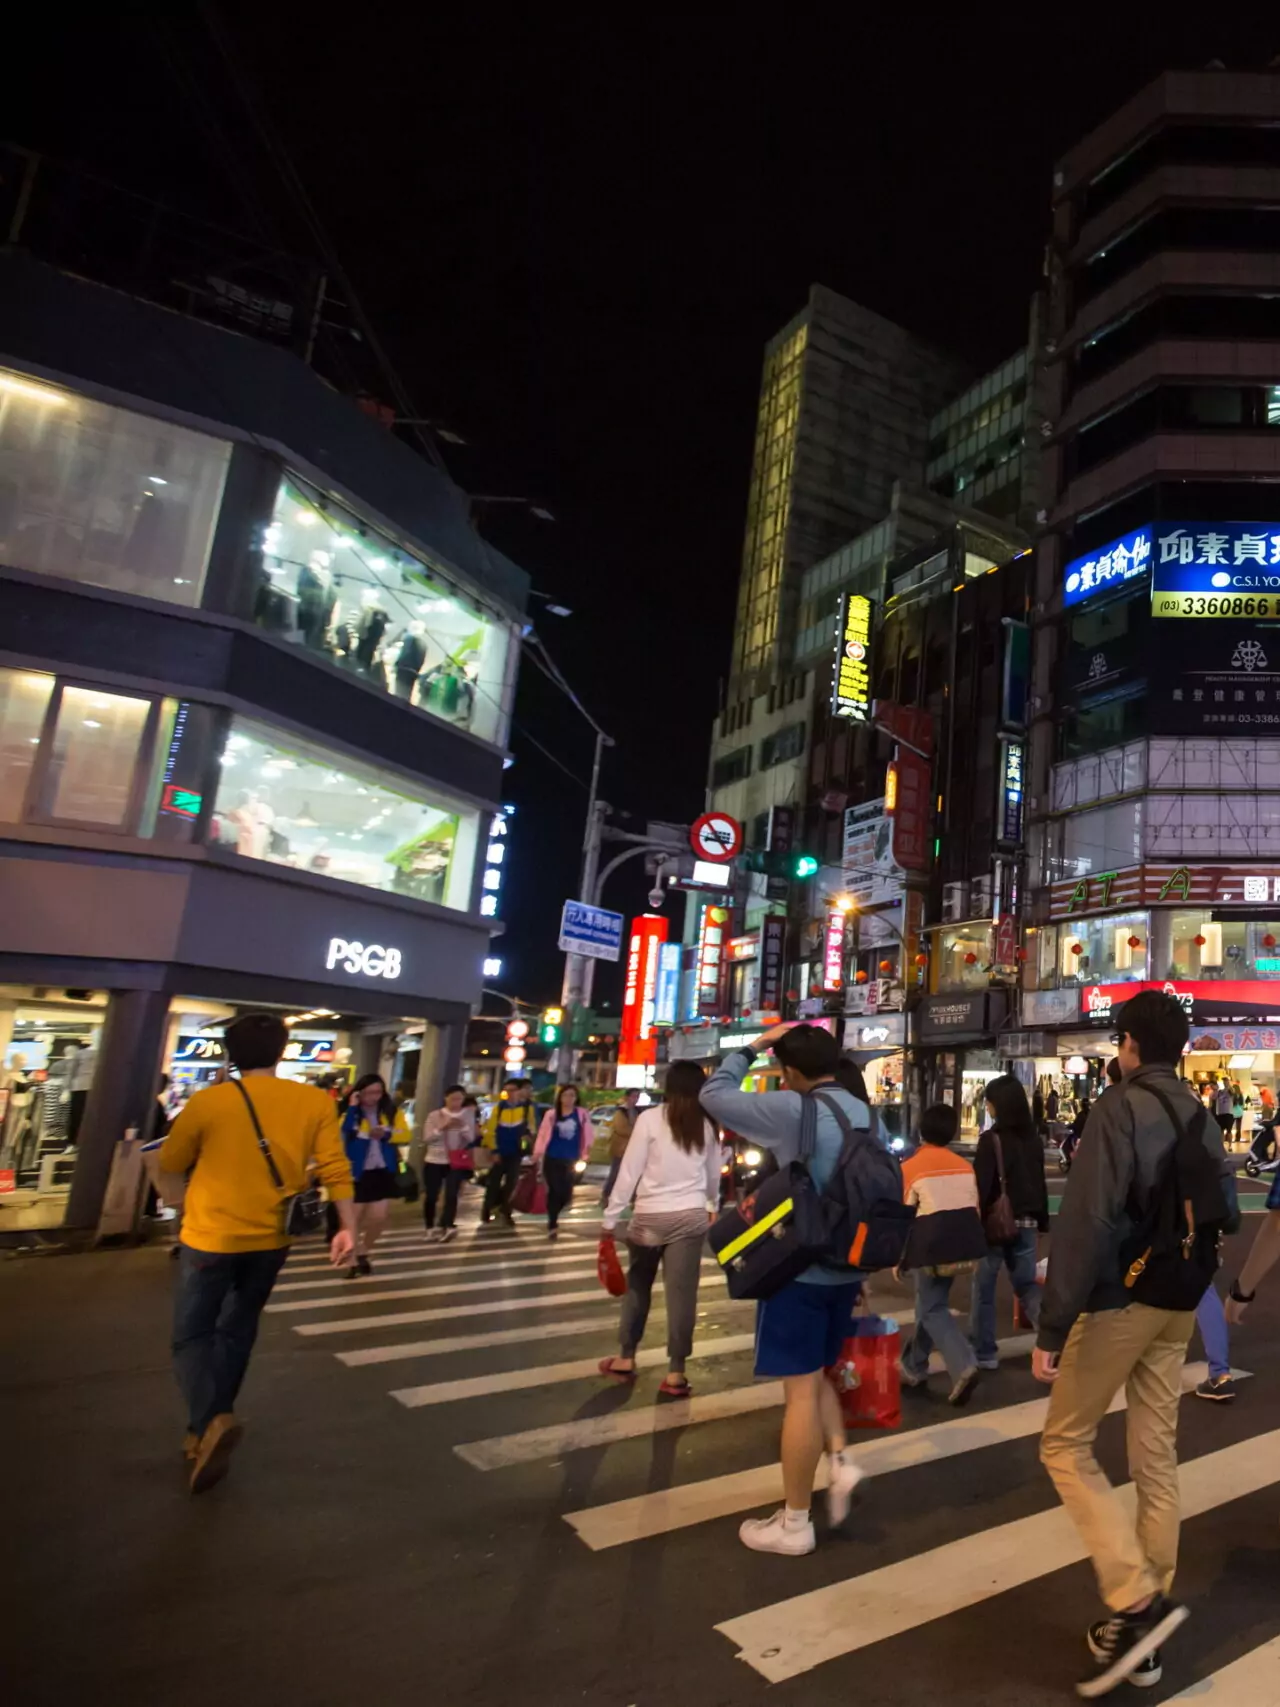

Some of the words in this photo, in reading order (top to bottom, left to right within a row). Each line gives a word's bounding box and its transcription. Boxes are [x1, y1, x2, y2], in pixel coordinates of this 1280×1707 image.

[1160, 600, 1180, 613] (03)
[1182, 597, 1270, 616] 3360866
[325, 937, 402, 979] PSGB
